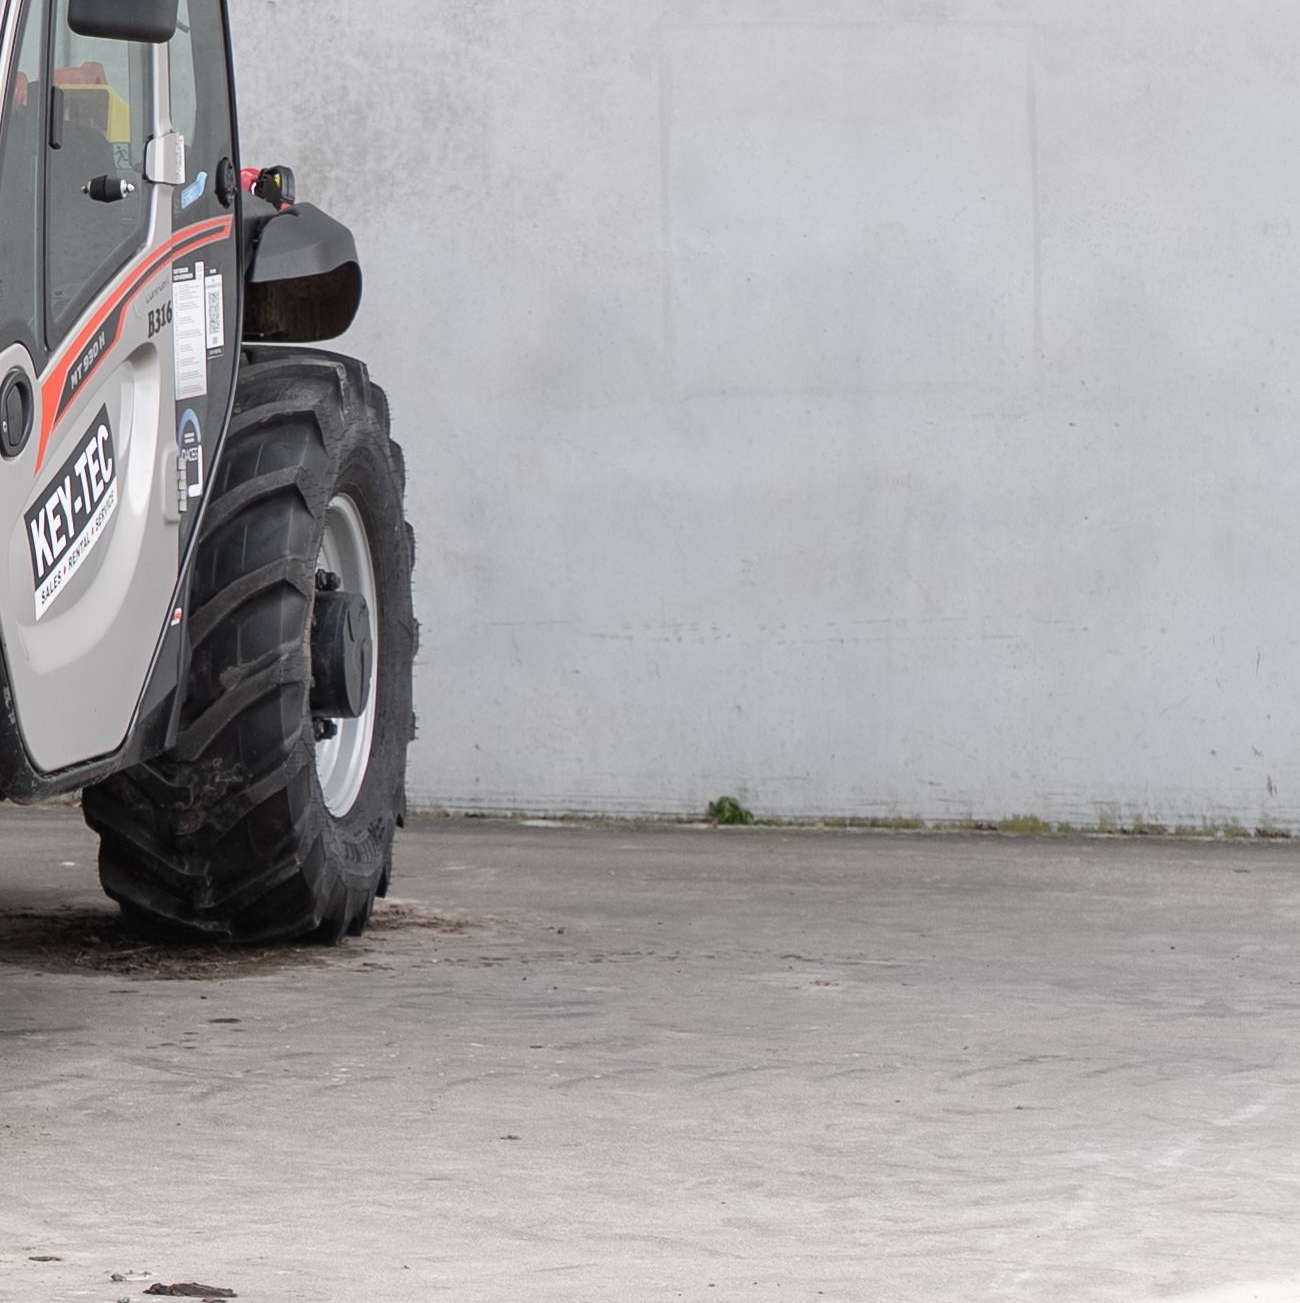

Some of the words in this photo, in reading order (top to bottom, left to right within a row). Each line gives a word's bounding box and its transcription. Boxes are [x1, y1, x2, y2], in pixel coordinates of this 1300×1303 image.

[70, 362, 83, 390] MT
[83, 345, 99, 373] 930
[99, 331, 106, 348] H
[148, 300, 173, 339] B316
[30, 424, 113, 578] KEY-TEC
[41, 572, 62, 604] SALES
[68, 536, 91, 570] RENTAL
[95, 489, 115, 532] SERVICE
